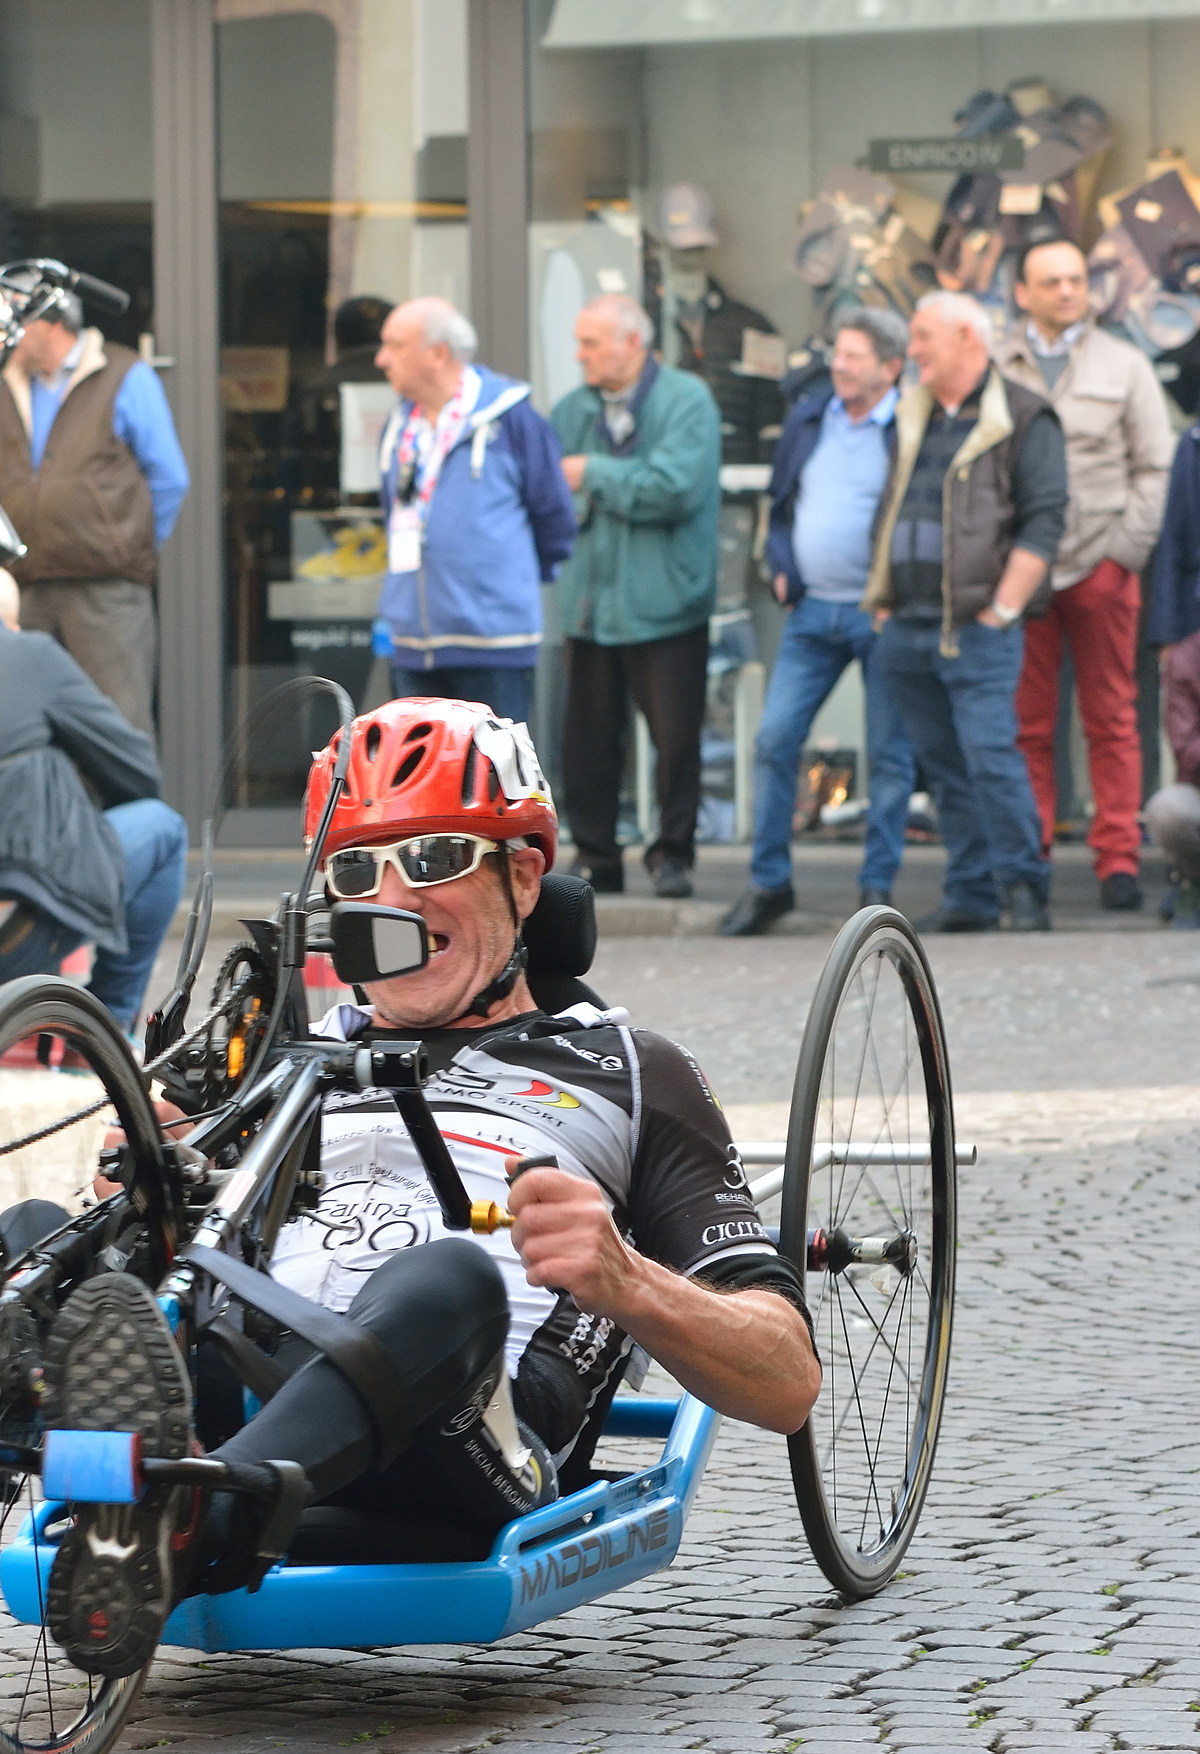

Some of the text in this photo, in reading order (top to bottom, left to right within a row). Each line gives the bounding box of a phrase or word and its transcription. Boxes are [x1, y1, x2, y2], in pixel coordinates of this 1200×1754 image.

[495, 1096, 567, 1128] SPORT
[701, 1220, 755, 1246] CICLI
[518, 1507, 669, 1606] MADDILINE
